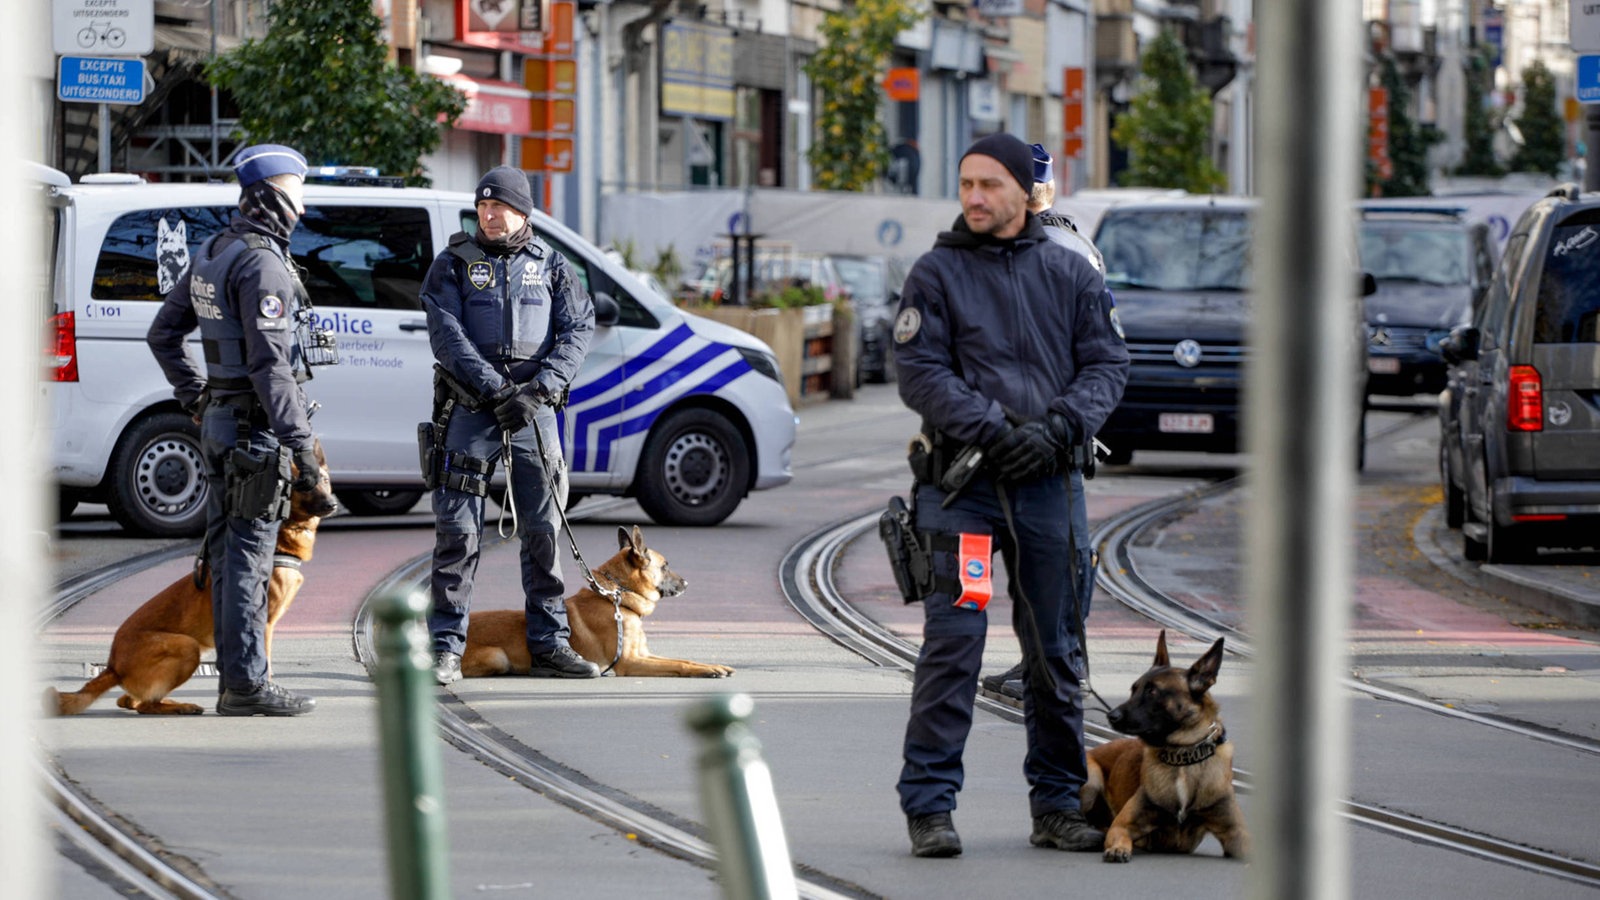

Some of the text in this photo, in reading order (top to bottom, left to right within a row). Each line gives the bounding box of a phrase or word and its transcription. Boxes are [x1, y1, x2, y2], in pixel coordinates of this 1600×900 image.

[73, 9, 129, 18] UITGEZONDERD
[80, 60, 125, 72] EXCEPTE
[77, 73, 126, 86] BUS/TAXI
[62, 86, 140, 100] UITGEZONDERD
[100, 306, 121, 317] 101
[309, 312, 373, 334] Police
